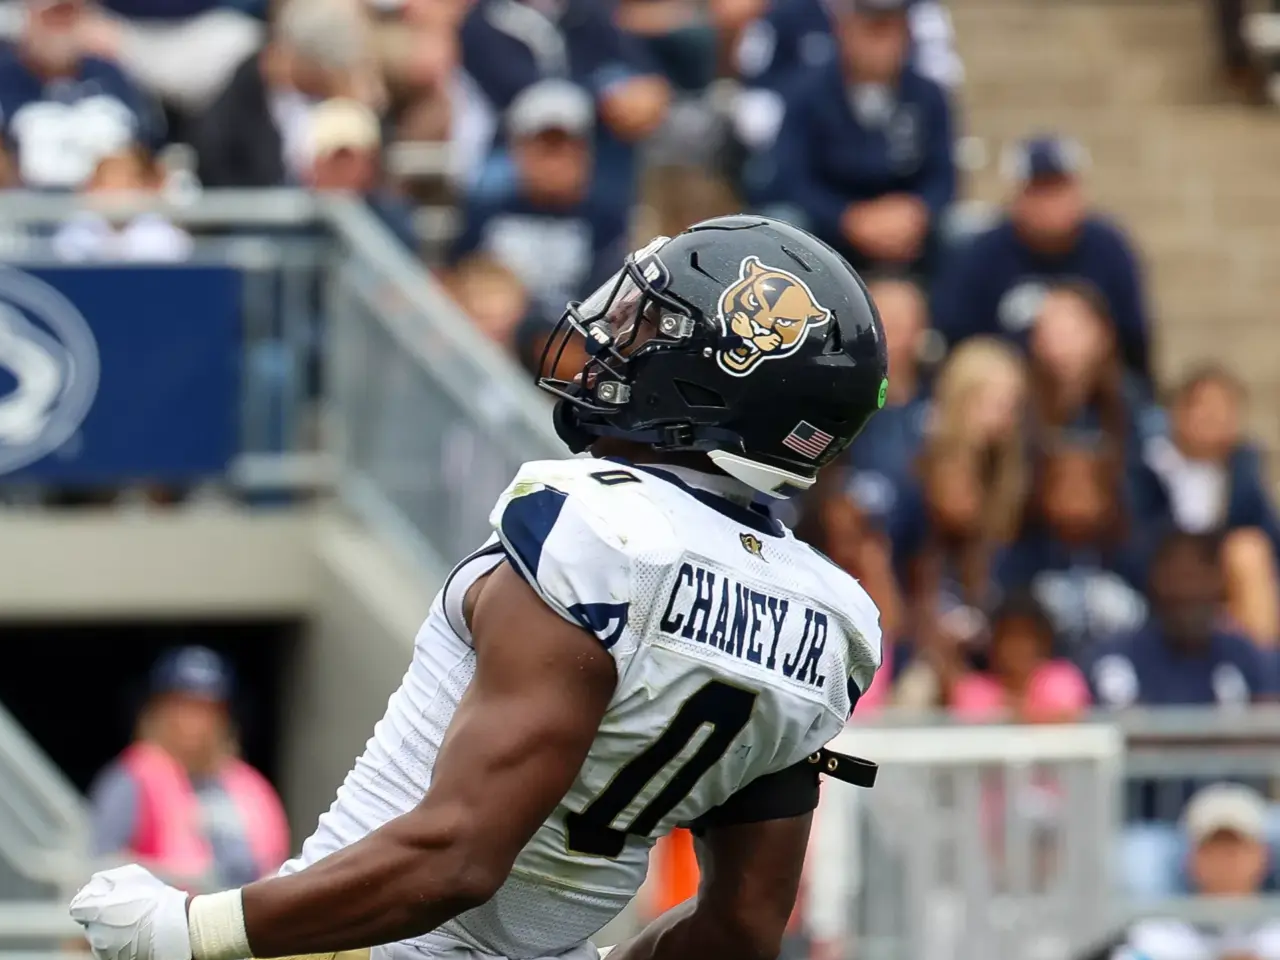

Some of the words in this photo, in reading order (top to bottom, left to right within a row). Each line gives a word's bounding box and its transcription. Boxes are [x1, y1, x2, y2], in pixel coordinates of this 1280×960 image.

[660, 562, 789, 671] CHANEY
[782, 607, 827, 688] JR.
[564, 677, 760, 860] 0
